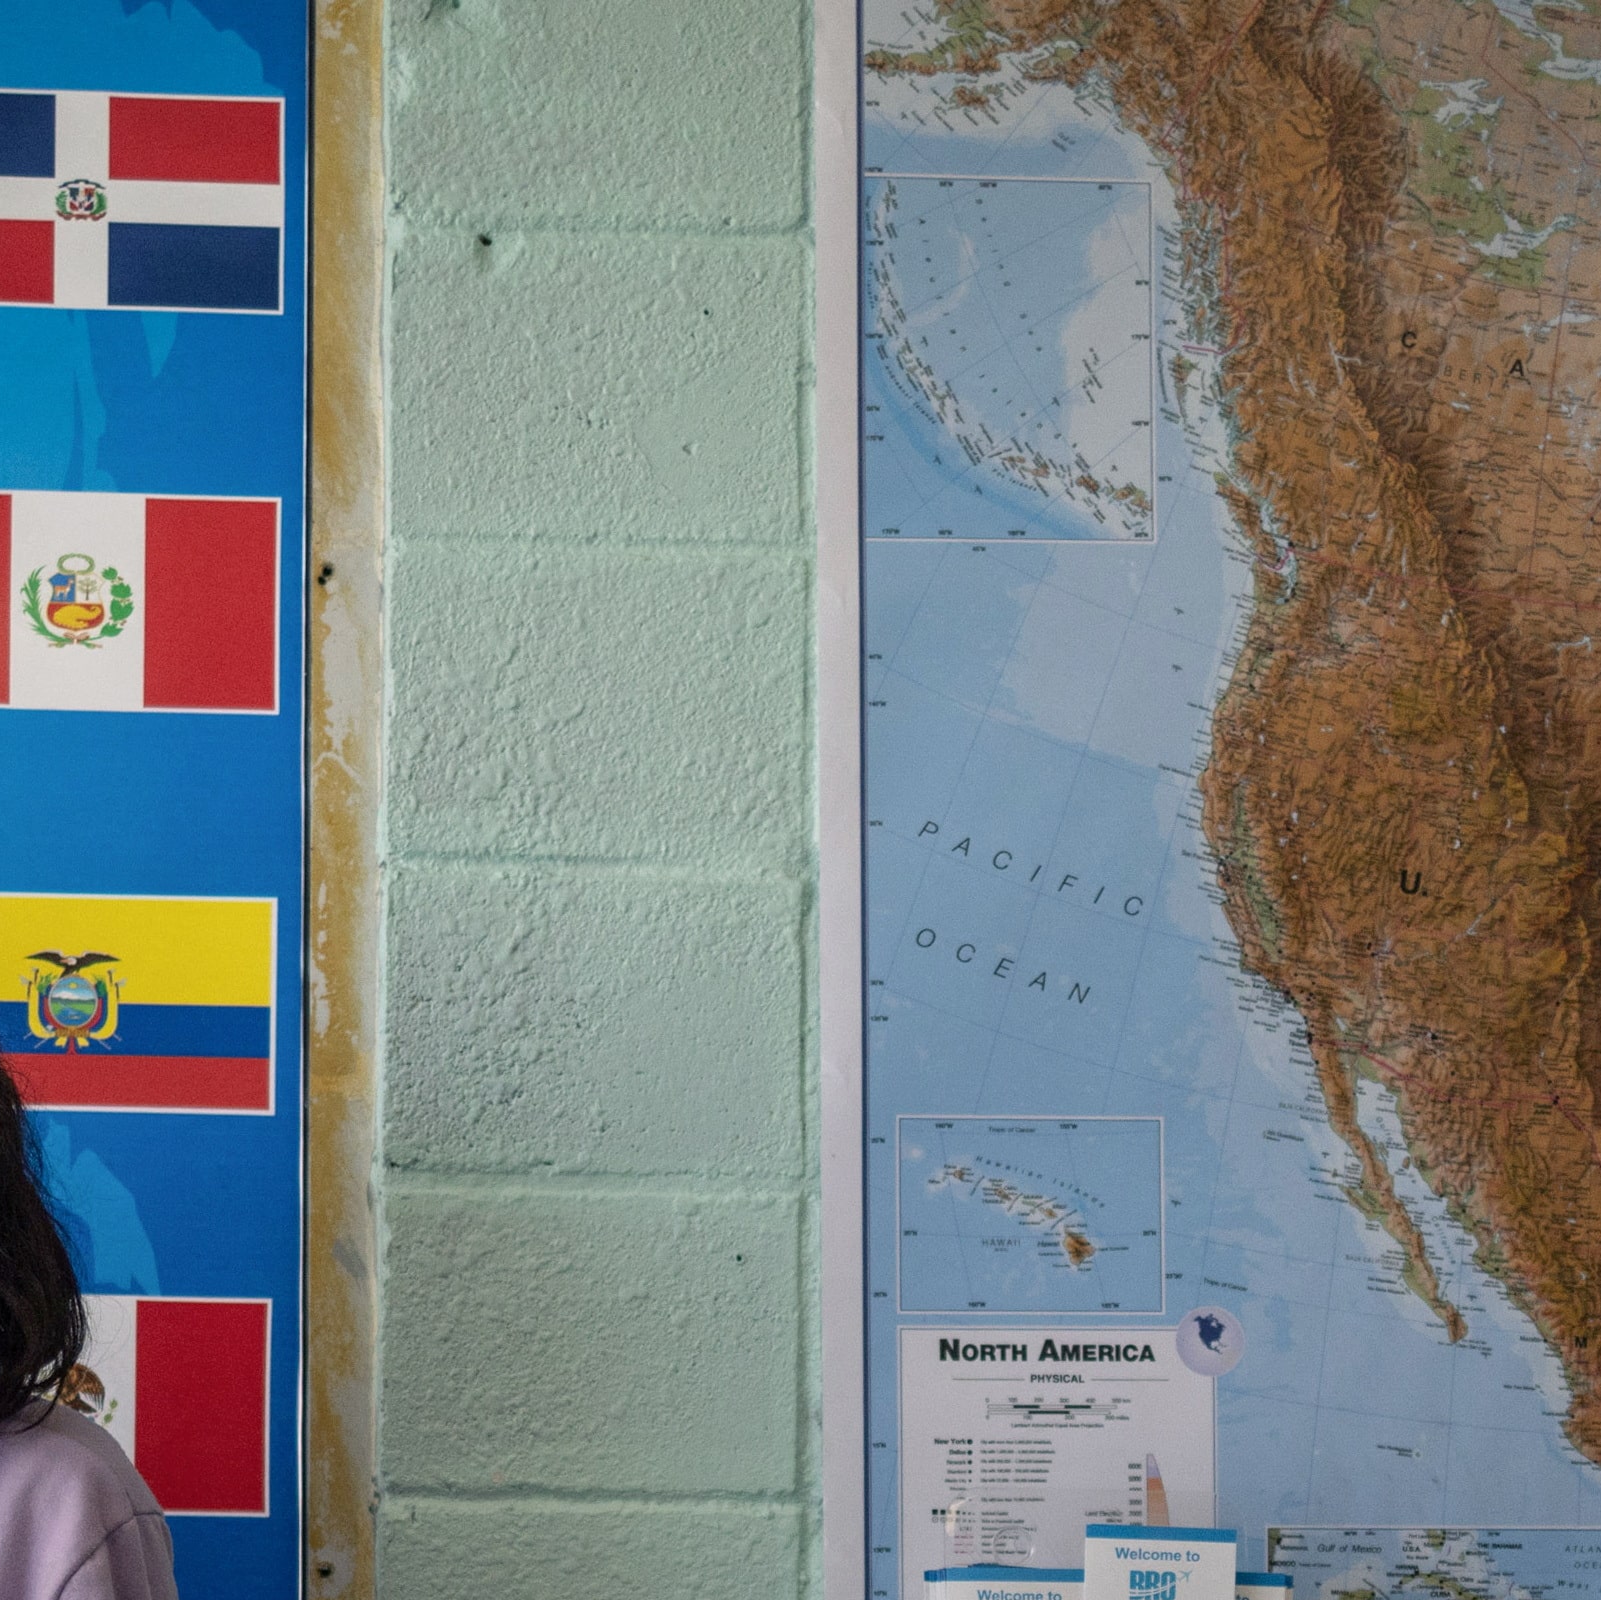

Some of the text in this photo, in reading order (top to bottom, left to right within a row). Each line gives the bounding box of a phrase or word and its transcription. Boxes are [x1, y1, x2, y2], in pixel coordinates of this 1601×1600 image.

[918, 820, 1145, 918] PACIFIC
[916, 927, 1092, 1005] OCEAN
[976, 1155, 1043, 1180] Hawaiian
[1053, 1178, 1105, 1208] Islands
[938, 1338, 1156, 1362] NORTH AMERICA
[1030, 1374, 1084, 1383] PHYSICAL
[1115, 1547, 1201, 1562] Welcome to
[1317, 1544, 1382, 1554] Gulf of Mexico
